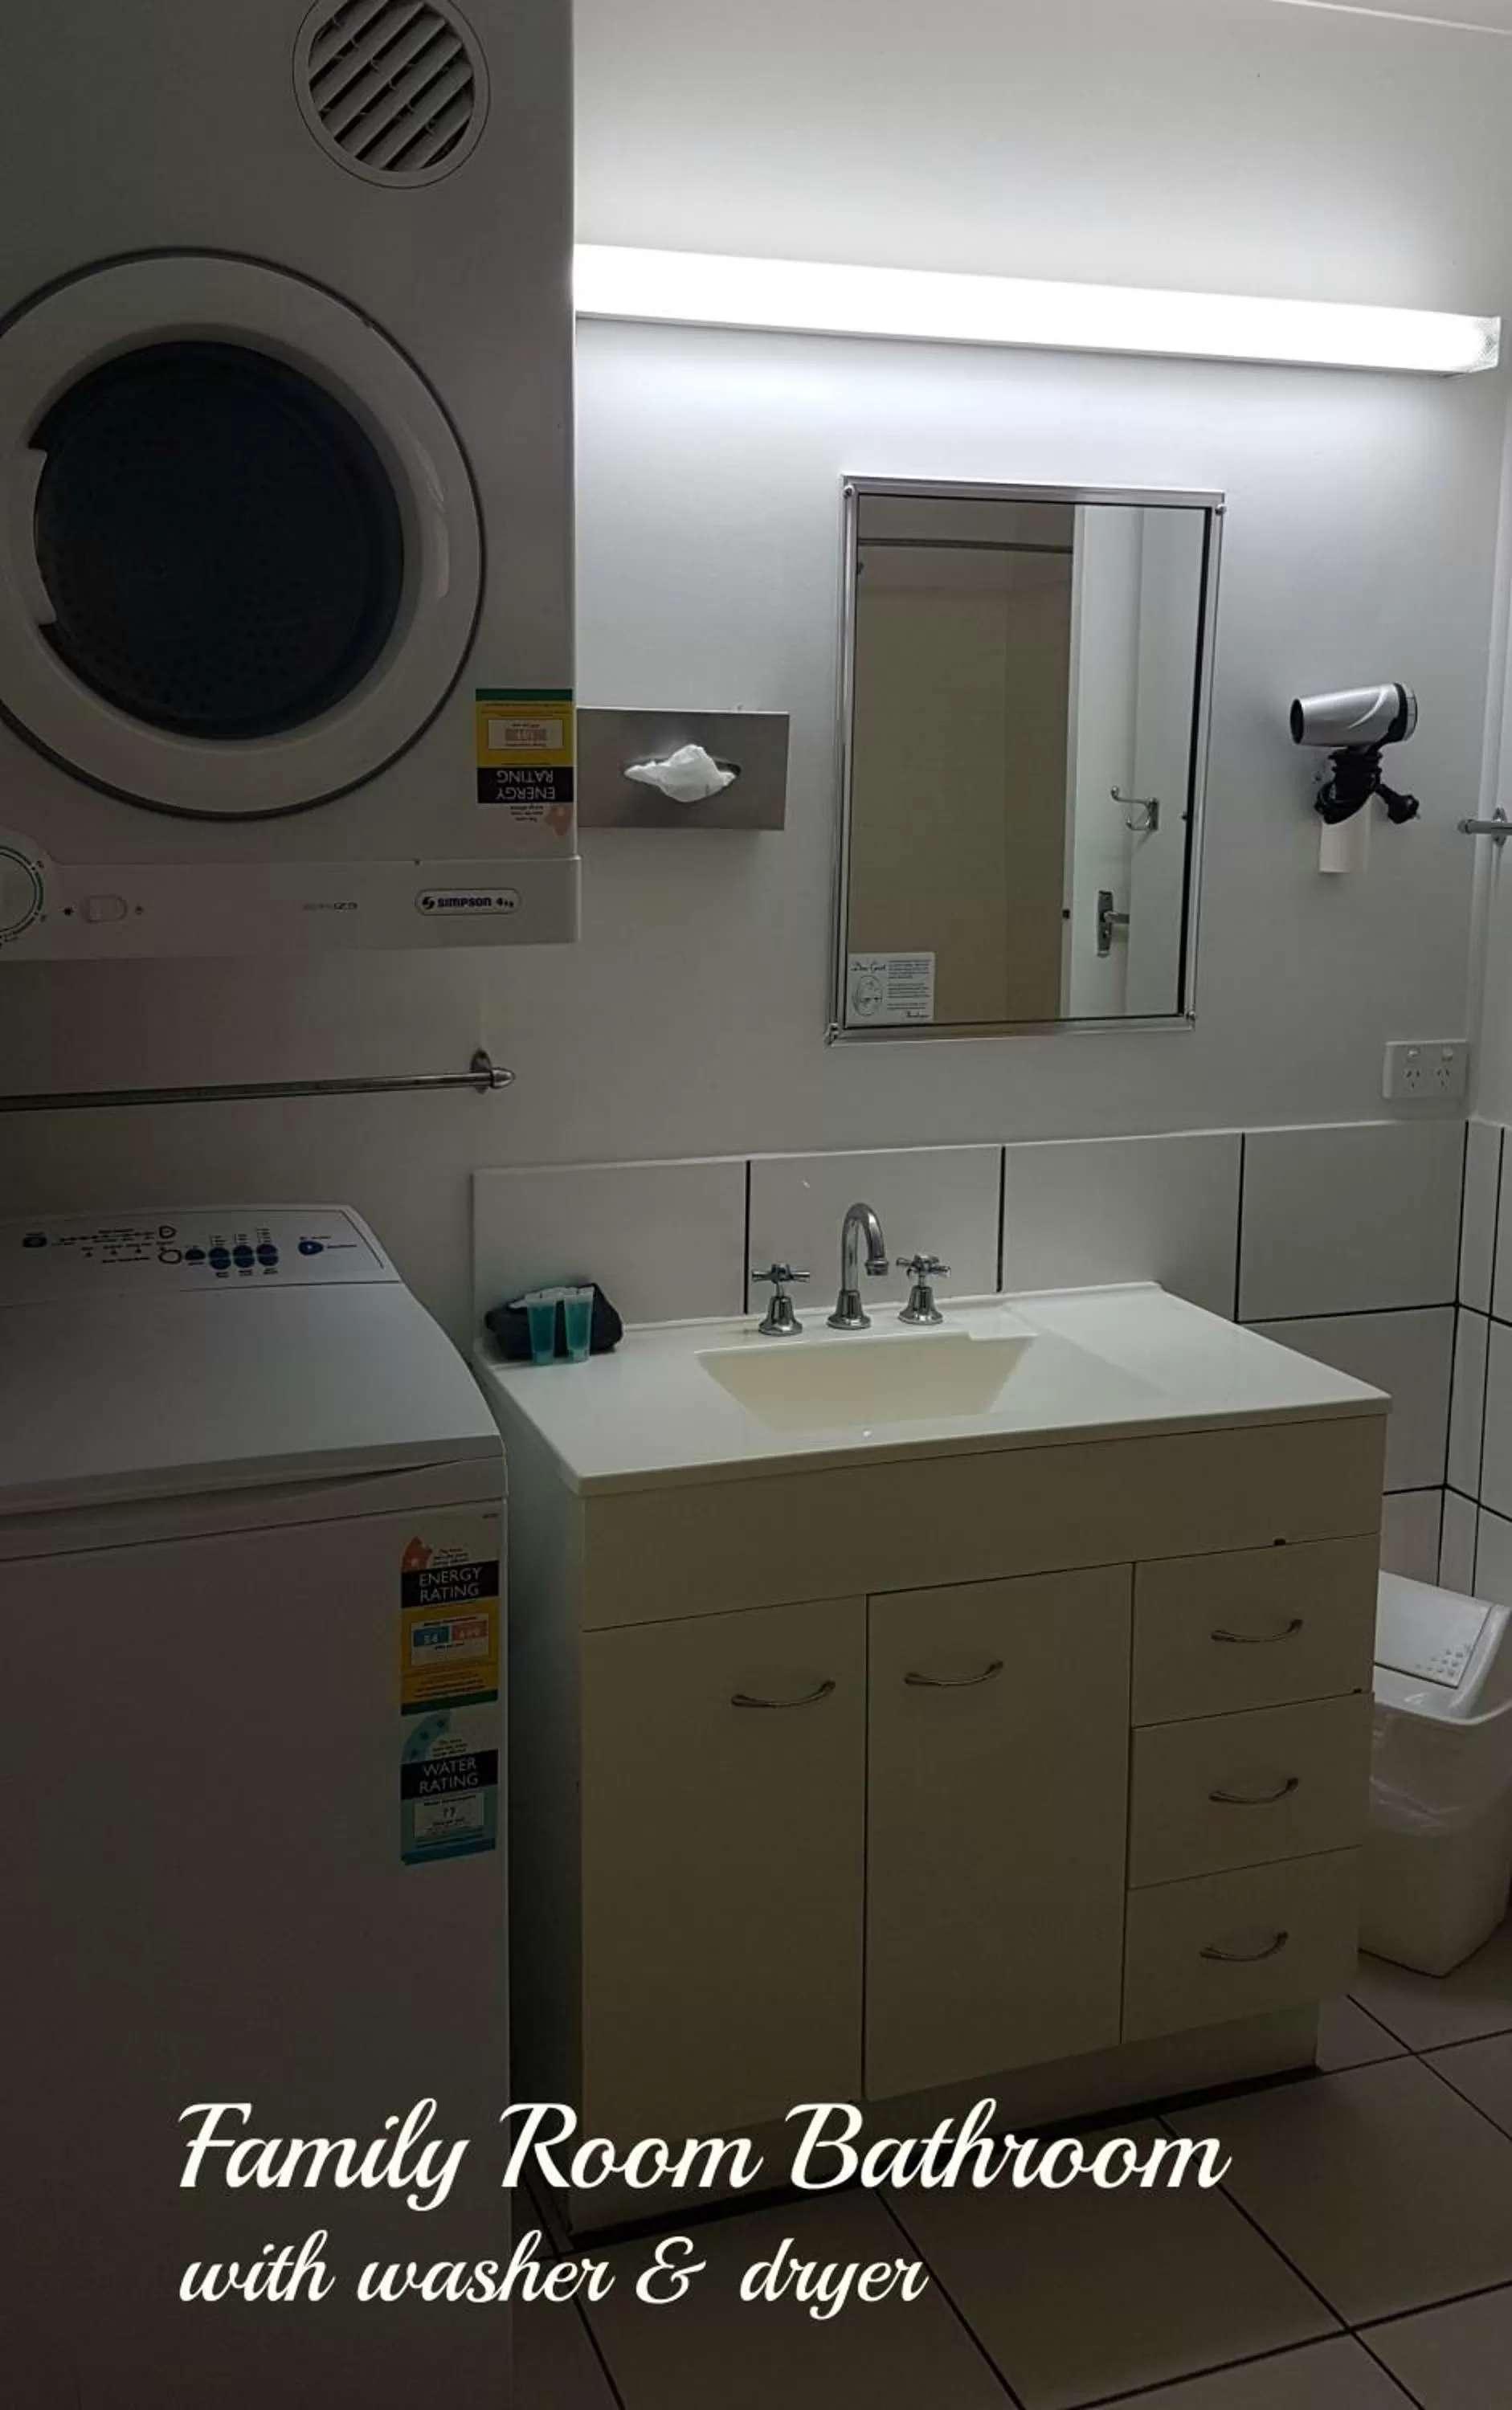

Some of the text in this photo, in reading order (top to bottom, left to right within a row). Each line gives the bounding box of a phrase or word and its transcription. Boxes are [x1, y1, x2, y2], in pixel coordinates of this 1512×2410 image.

[496, 770, 554, 783] RATING
[496, 786, 556, 801] ENERGY
[437, 897, 492, 908] SIMPSON
[419, 1566, 482, 1587] ENERGY
[420, 1583, 480, 1603] RATING
[423, 1757, 476, 1777] WATER
[419, 1771, 479, 1794] RATING
